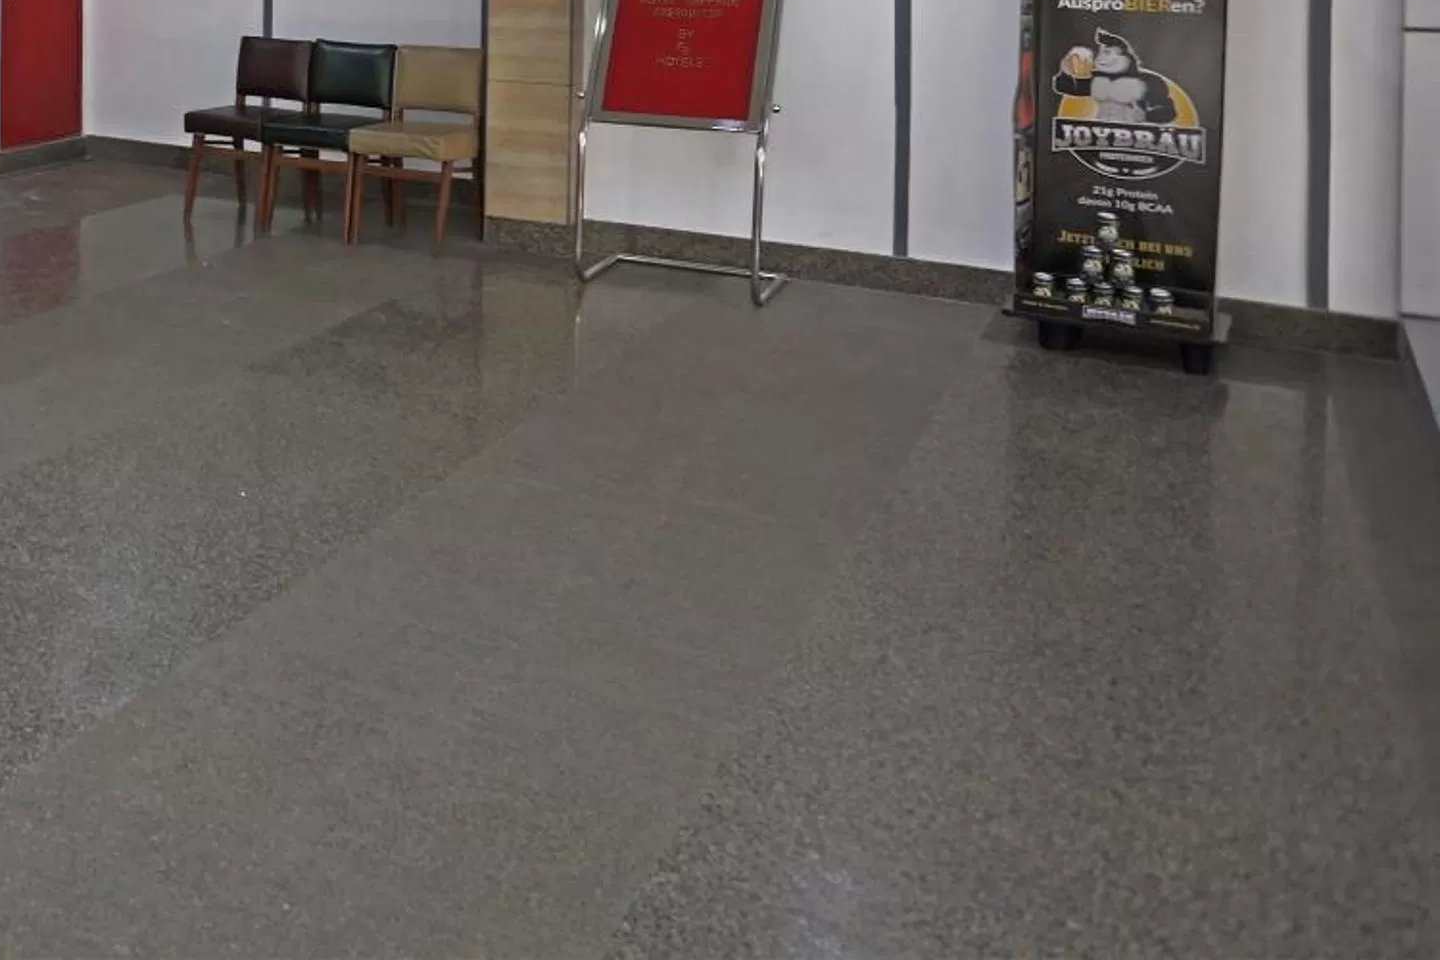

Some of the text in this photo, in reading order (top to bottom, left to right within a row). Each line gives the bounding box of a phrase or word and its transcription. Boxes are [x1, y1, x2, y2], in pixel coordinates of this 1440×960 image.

[1055, 124, 1200, 160] JOYBRÄU
[1116, 188, 1158, 201] Protein
[1138, 202, 1173, 215] BCAA
